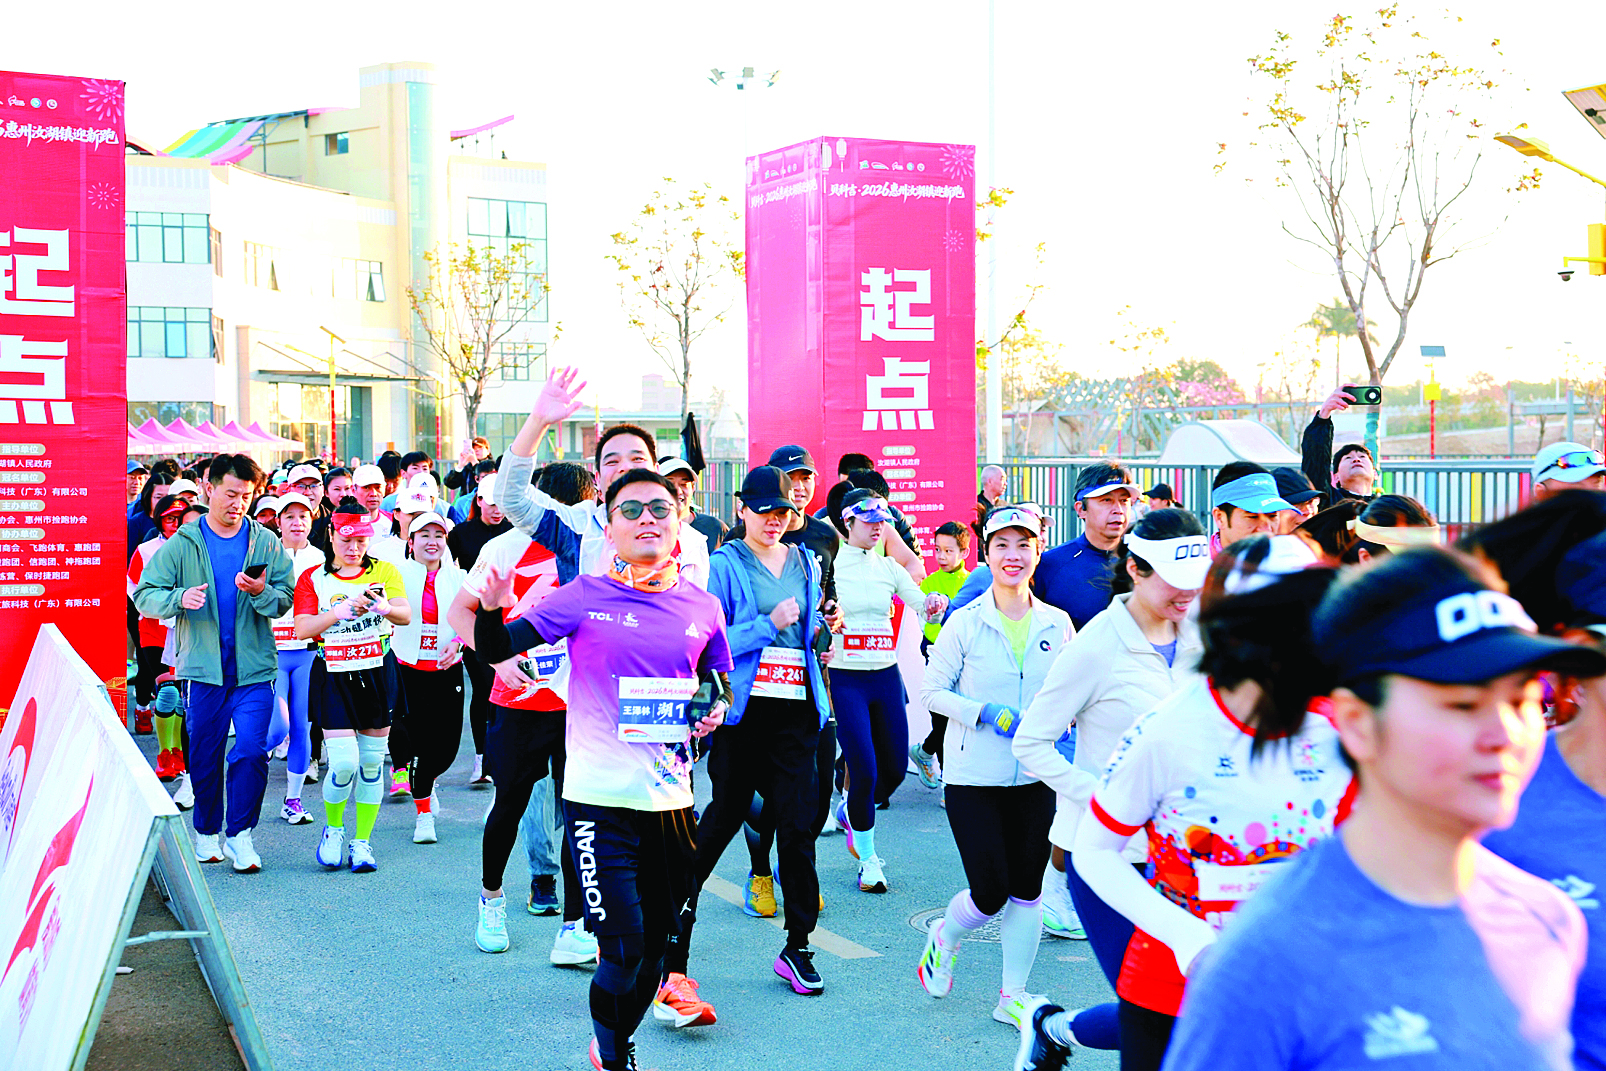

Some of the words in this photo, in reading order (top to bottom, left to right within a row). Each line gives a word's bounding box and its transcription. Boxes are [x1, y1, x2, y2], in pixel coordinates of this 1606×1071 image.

[860, 267, 935, 430] 起点
[2, 445, 39, 454] 指导单位
[2, 473, 39, 482] 冠名单位
[2, 501, 39, 510] 主办单位
[2, 529, 39, 538] 协办单位
[0, 543, 101, 552] 商会、飞跑体育、惠跑团
[2, 586, 39, 594] 执行单位
[0, 598, 101, 608] 旅科技（广东）有限公司
[588, 611, 614, 621] TCL
[574, 820, 606, 922] JORDAN
